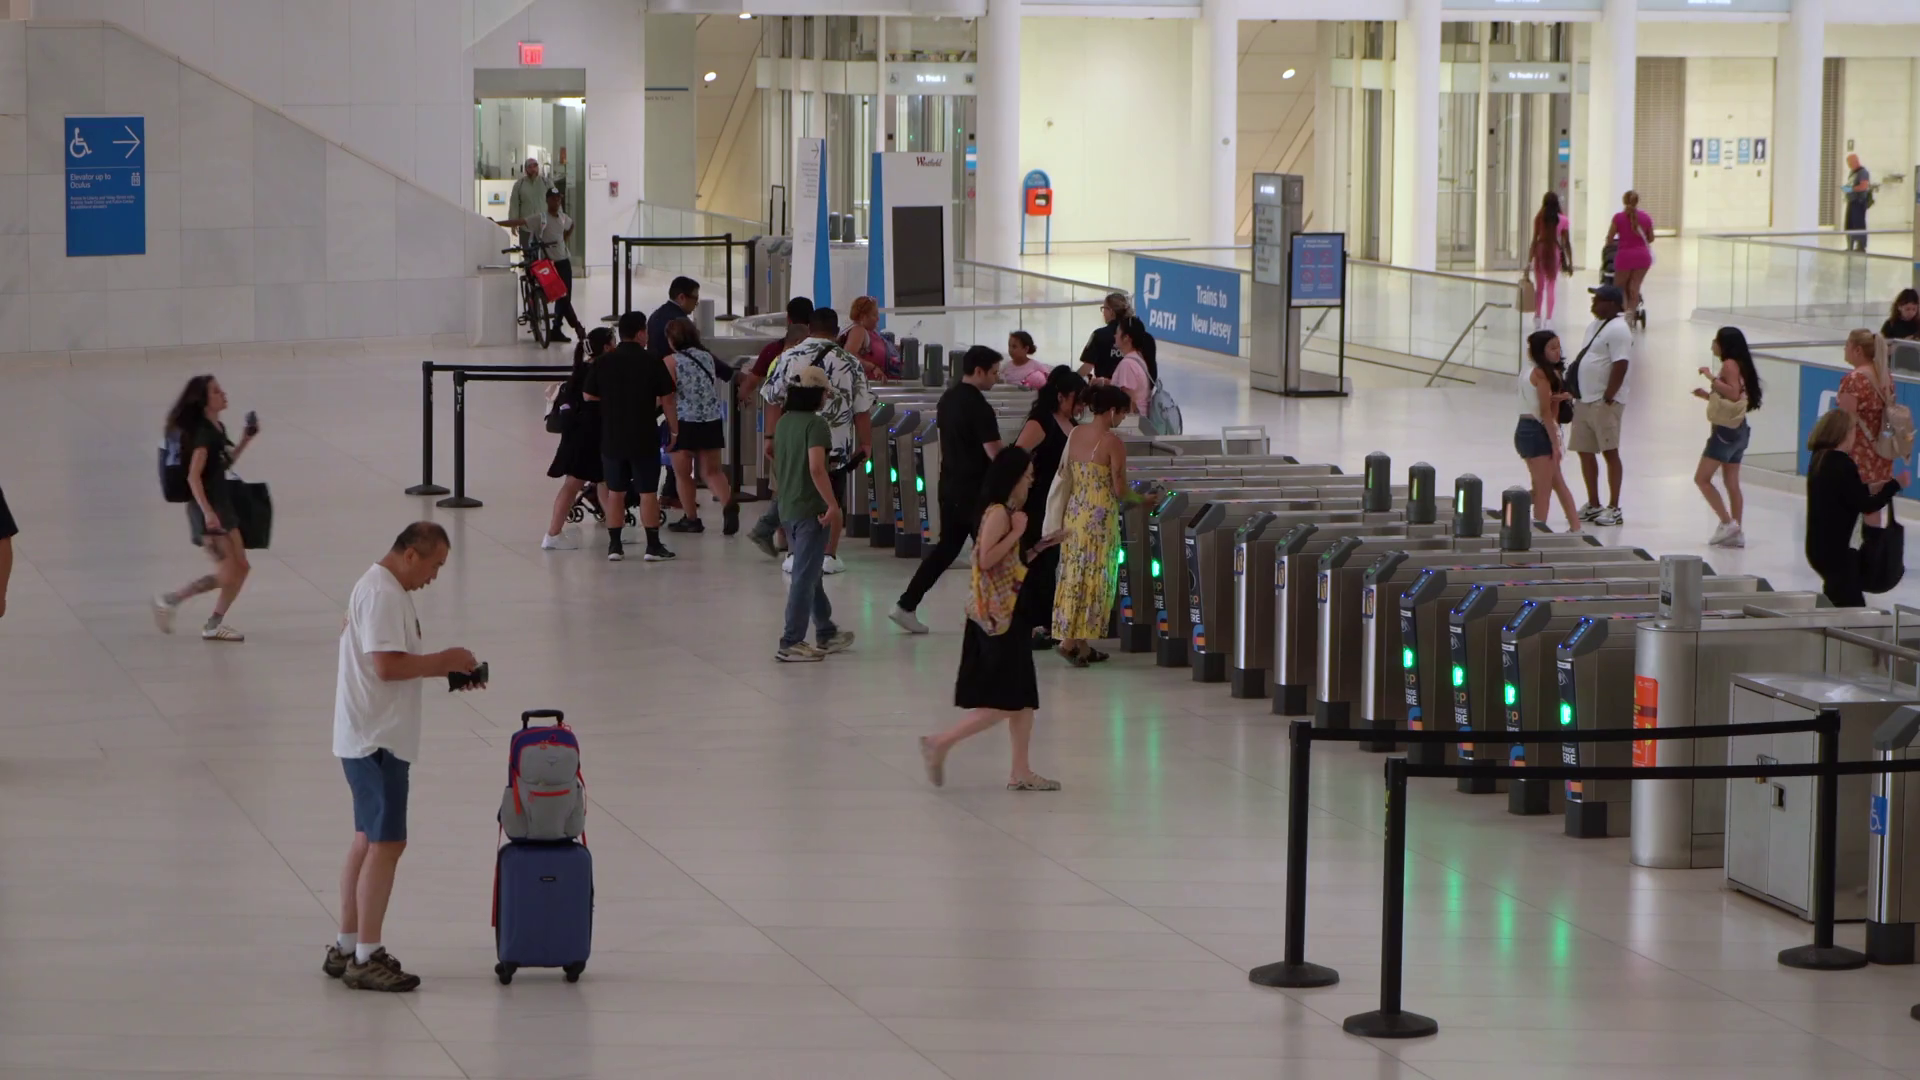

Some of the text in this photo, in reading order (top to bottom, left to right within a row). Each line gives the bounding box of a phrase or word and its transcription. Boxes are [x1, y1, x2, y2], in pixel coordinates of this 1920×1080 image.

[70, 173, 94, 181] Elevator
[1196, 284, 1228, 309] Trains to
[1149, 309, 1177, 332] PATH
[1191, 313, 1232, 345] New Jersey
